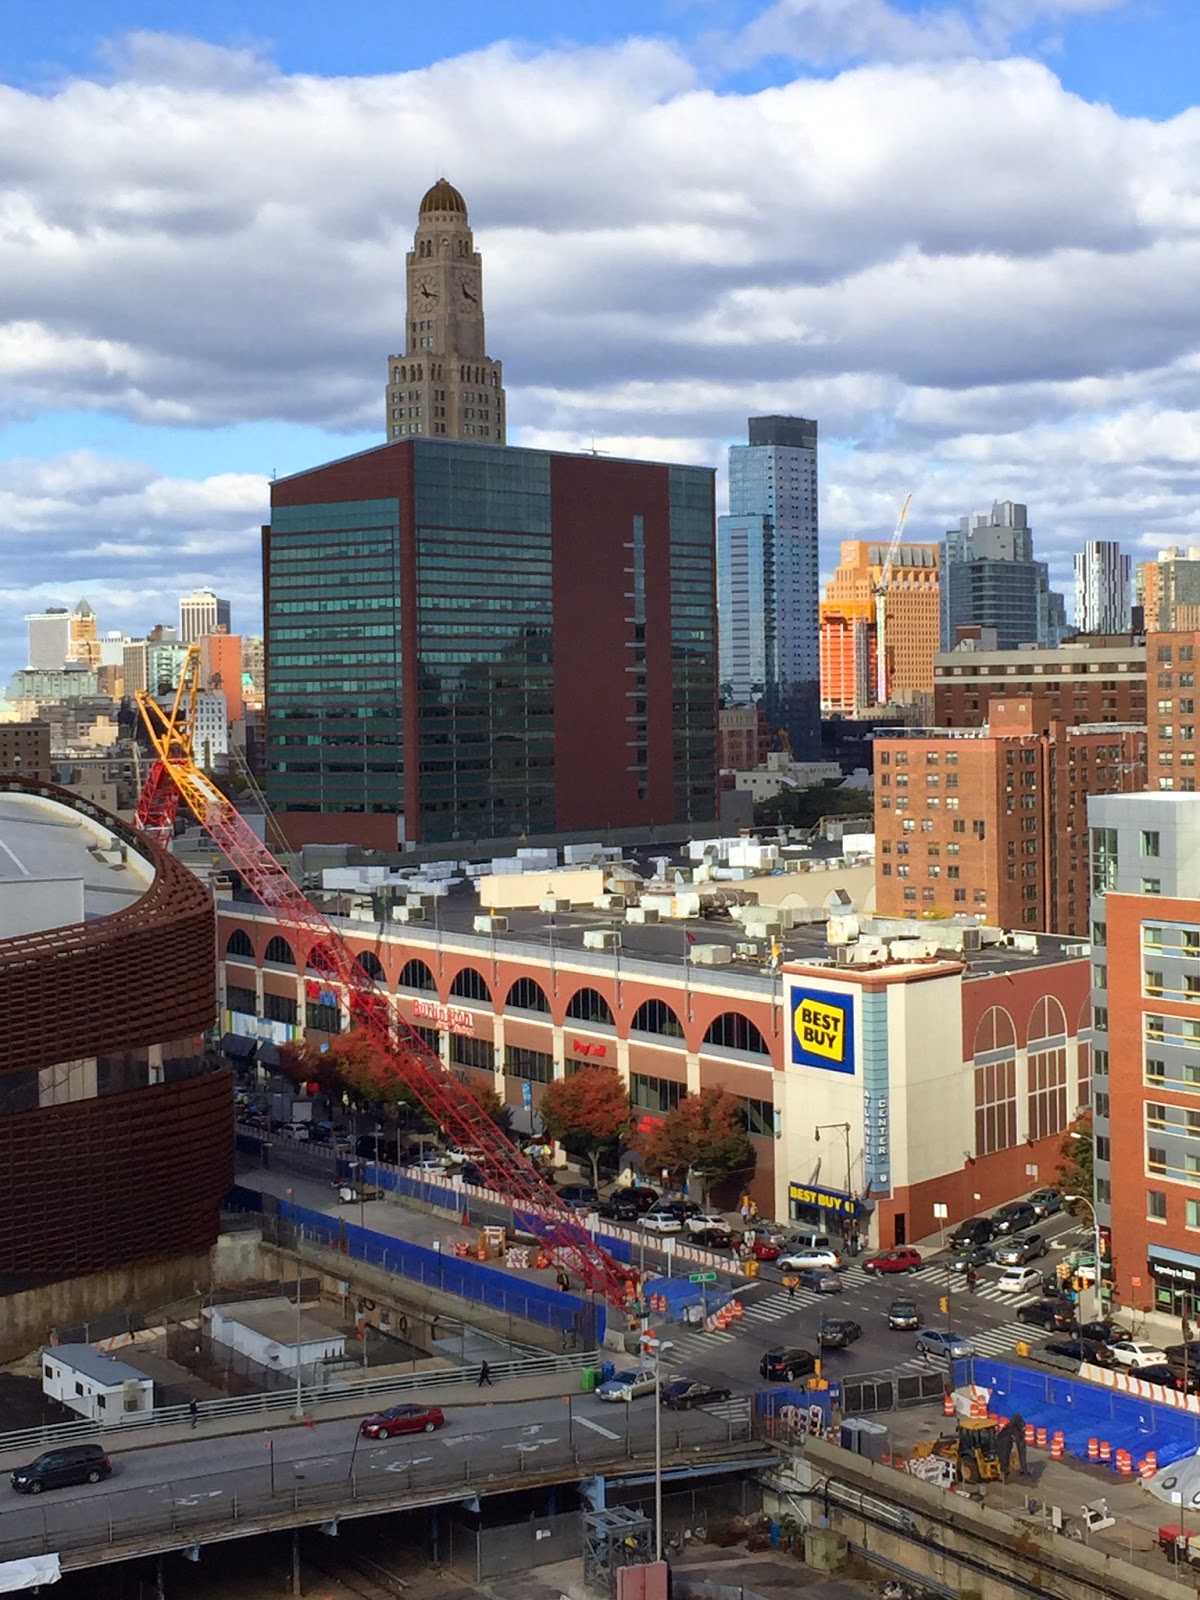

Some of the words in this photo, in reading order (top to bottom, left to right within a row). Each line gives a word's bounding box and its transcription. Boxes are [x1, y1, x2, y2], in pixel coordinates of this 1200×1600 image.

[802, 1007, 840, 1032] BEST
[804, 1026, 837, 1049] BUY
[863, 1089, 871, 1163] ATLANTIC
[878, 1100, 887, 1155] CENTER
[790, 1186, 817, 1203] BEST
[818, 1193, 842, 1210] BUY
